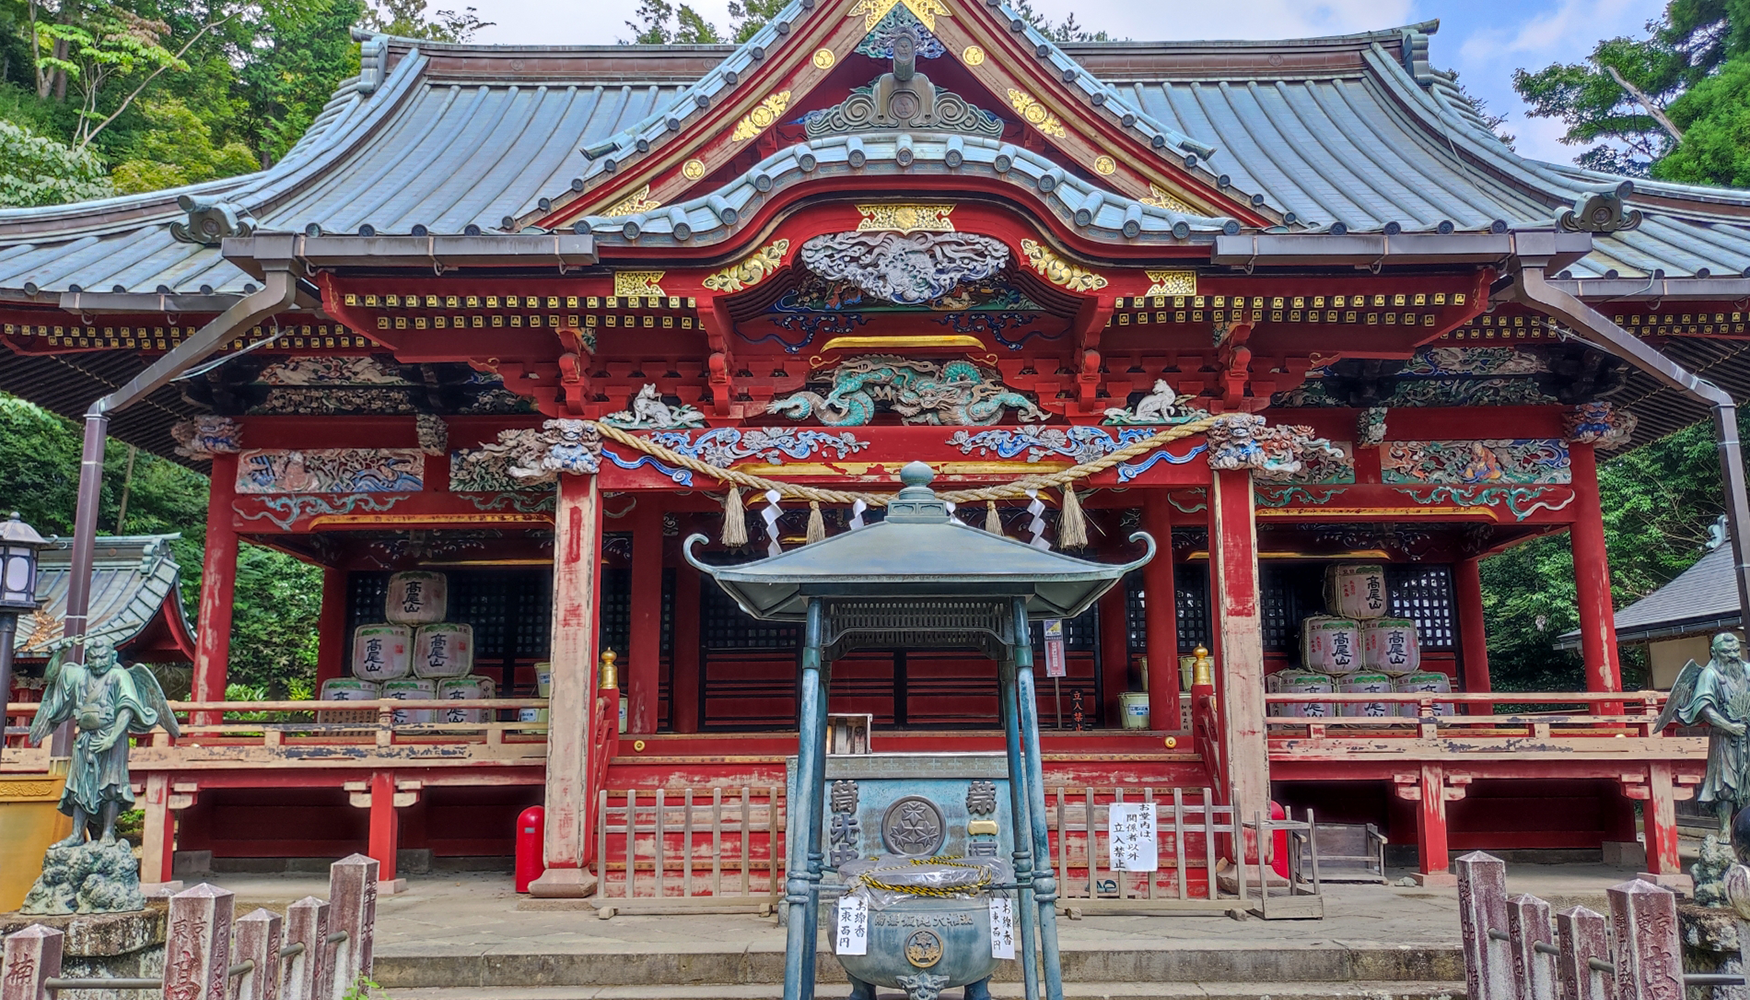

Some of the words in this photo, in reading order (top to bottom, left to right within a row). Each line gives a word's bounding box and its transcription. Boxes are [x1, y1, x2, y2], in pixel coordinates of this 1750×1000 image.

[402, 581, 424, 613] 高尾山
[1365, 575, 1384, 610] 高尾山
[364, 638, 384, 673] 高尾山
[427, 634, 448, 668] 高尾山
[1331, 631, 1352, 666] 高尾山
[1386, 630, 1408, 665] 高尾山
[1072, 690, 1084, 732] 立入禁止
[830, 780, 860, 866] 筒先中
[1126, 814, 1139, 861] 関係者以外
[1139, 804, 1151, 842] お堂内は、
[1113, 822, 1126, 869] 立入禁止
[171, 917, 207, 942] 東京
[839, 905, 852, 948] 一束百円
[854, 900, 867, 938] お線香
[991, 906, 1001, 951] 一束百円
[1002, 903, 1013, 946] お線香
[1637, 912, 1674, 936] 東京
